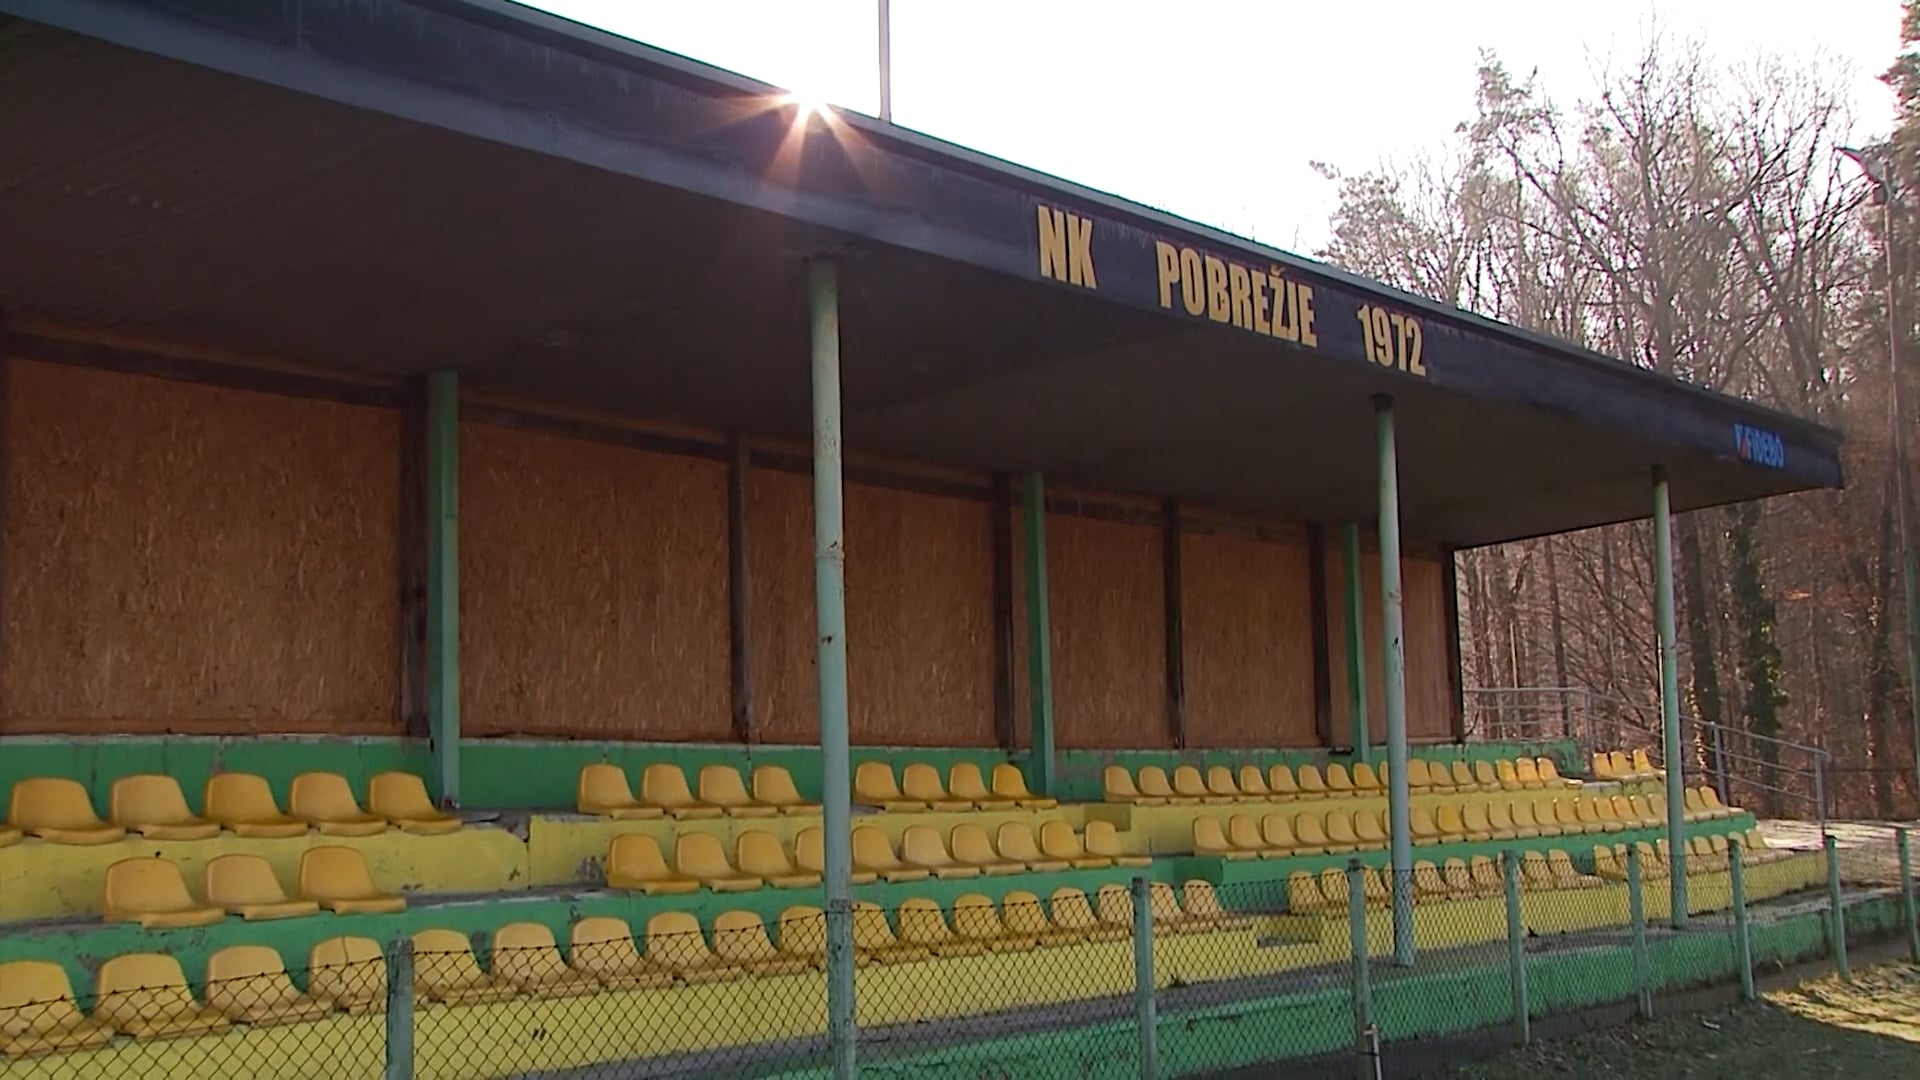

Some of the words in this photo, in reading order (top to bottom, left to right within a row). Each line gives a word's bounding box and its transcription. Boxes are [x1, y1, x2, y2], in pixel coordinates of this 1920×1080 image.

[1037, 205, 1097, 289] NK
[1156, 241, 1318, 348] POBREŽJE
[1357, 304, 1427, 376] 1972
